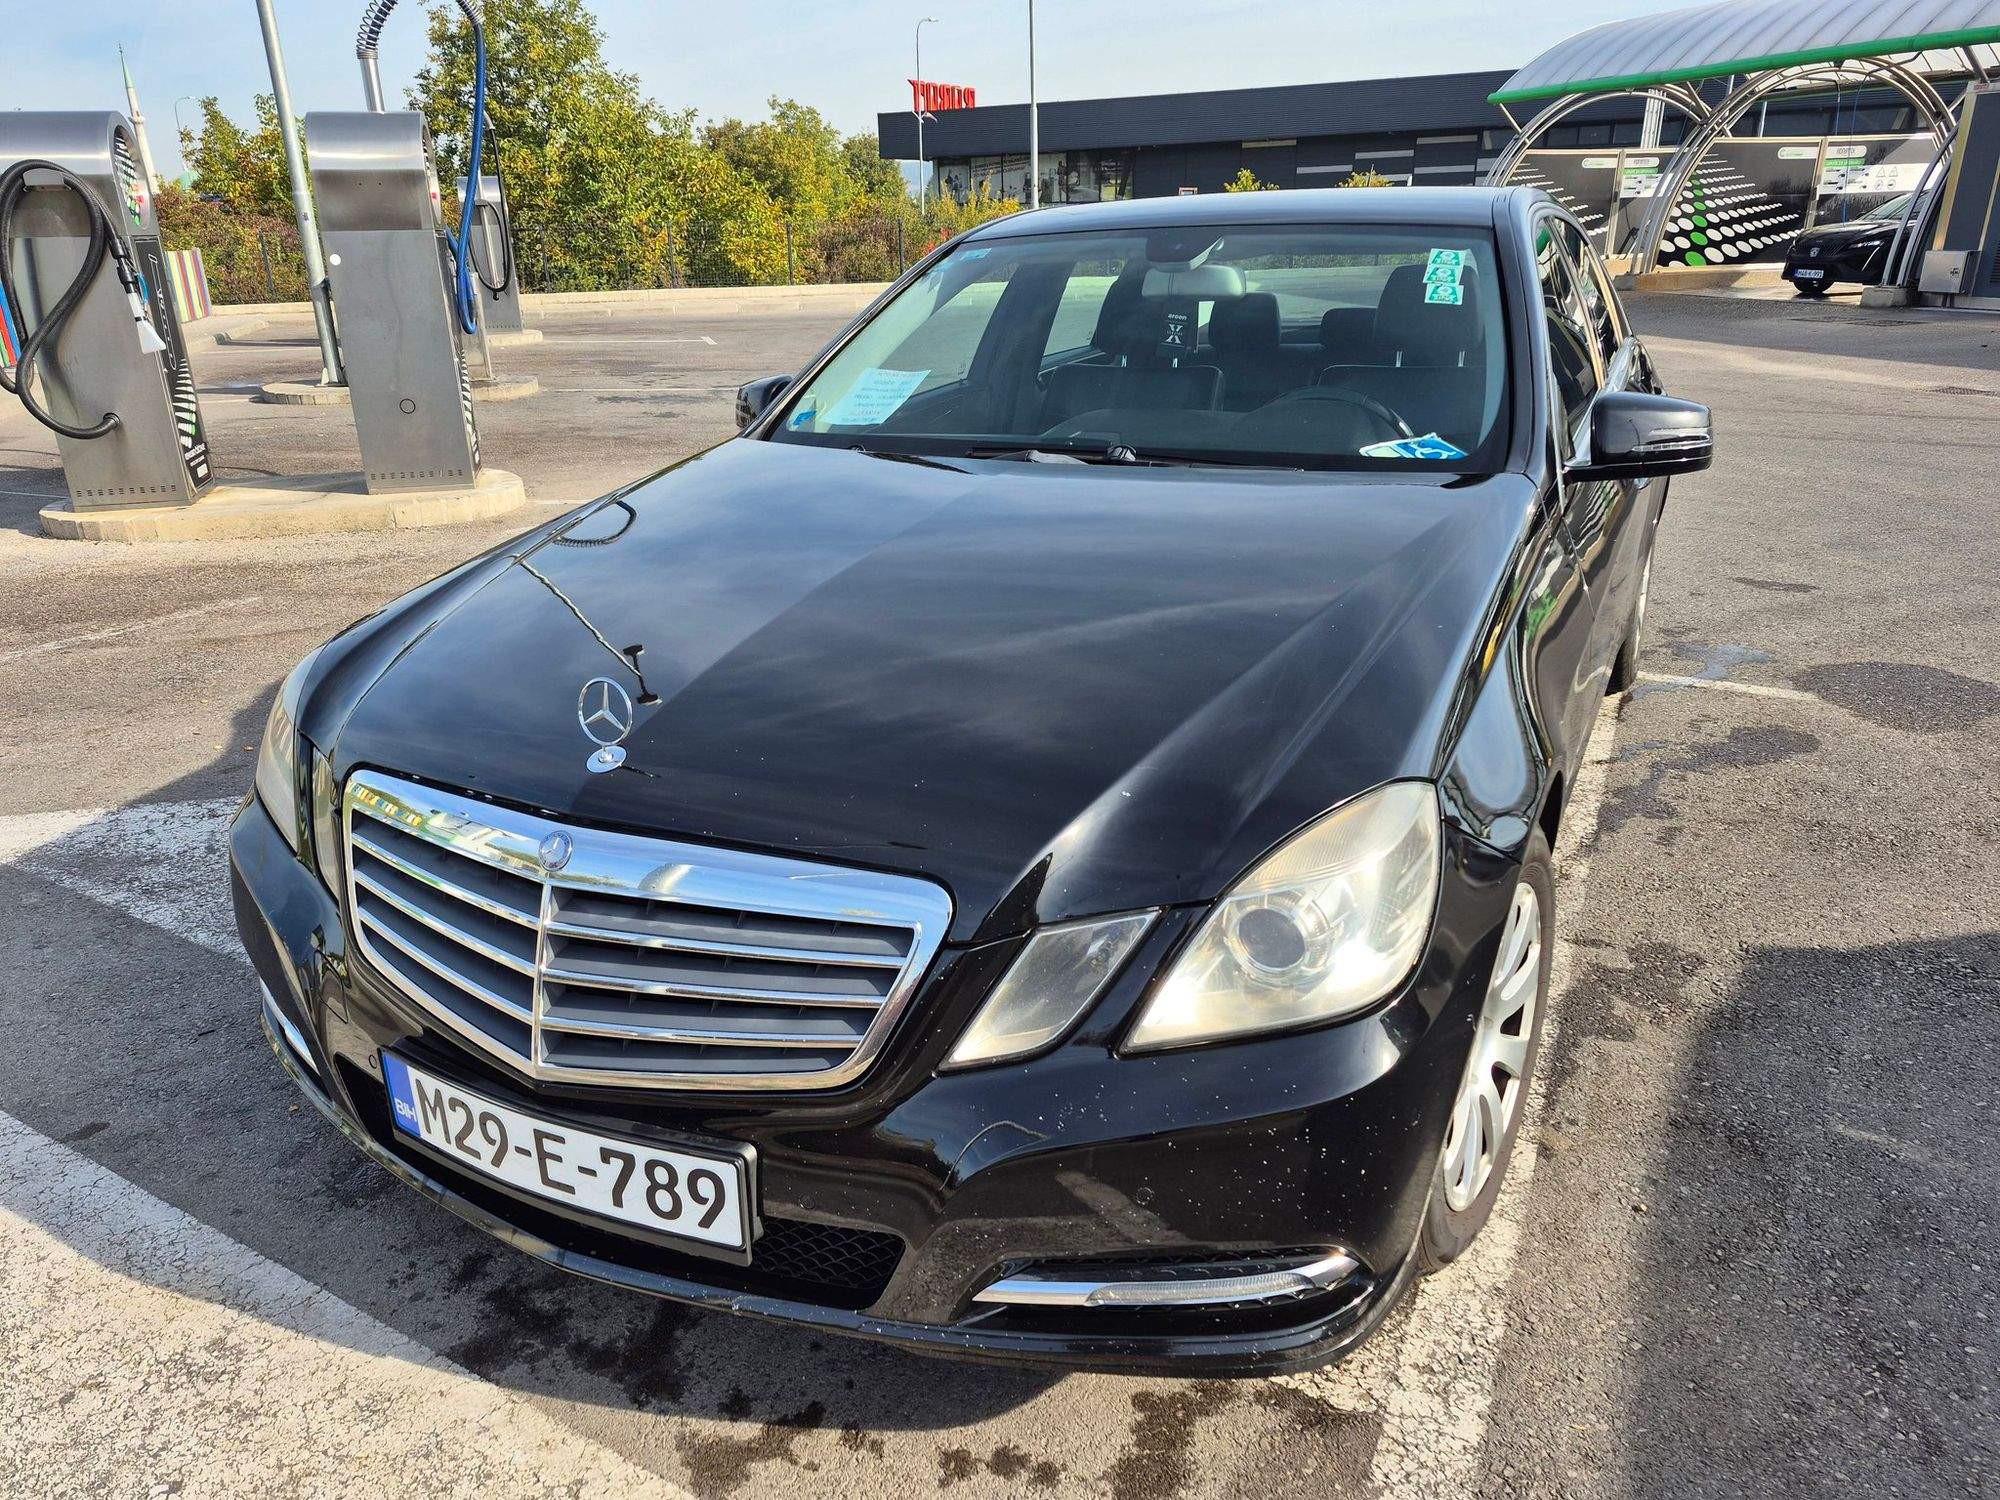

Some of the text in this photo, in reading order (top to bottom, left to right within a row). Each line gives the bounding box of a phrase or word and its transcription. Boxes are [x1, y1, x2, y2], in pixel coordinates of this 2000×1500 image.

[1167, 313, 1188, 321] areon
[394, 1097, 417, 1123] BIH
[415, 1078, 726, 1230] M29-E-789
